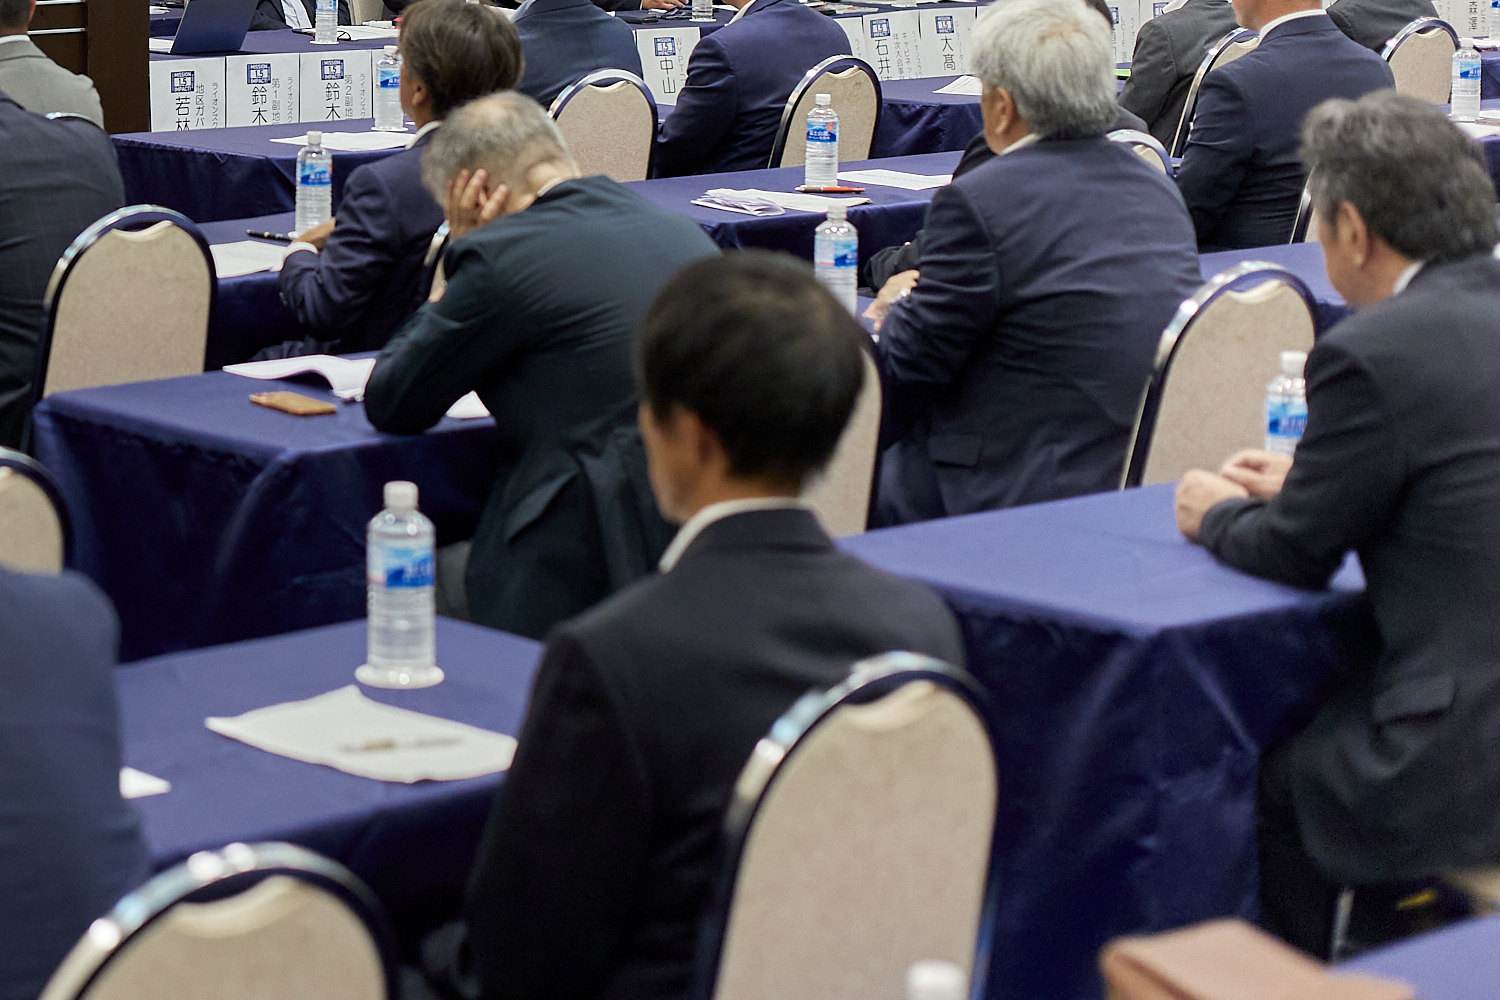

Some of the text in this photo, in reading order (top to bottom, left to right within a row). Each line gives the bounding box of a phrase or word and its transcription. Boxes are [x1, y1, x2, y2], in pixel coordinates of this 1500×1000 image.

[659, 57, 676, 93] 中山
[175, 96, 191, 131] 若林
[195, 83, 205, 127] 地区ガバ
[251, 86, 268, 126] 鈴木
[325, 82, 341, 121] 鈴木
